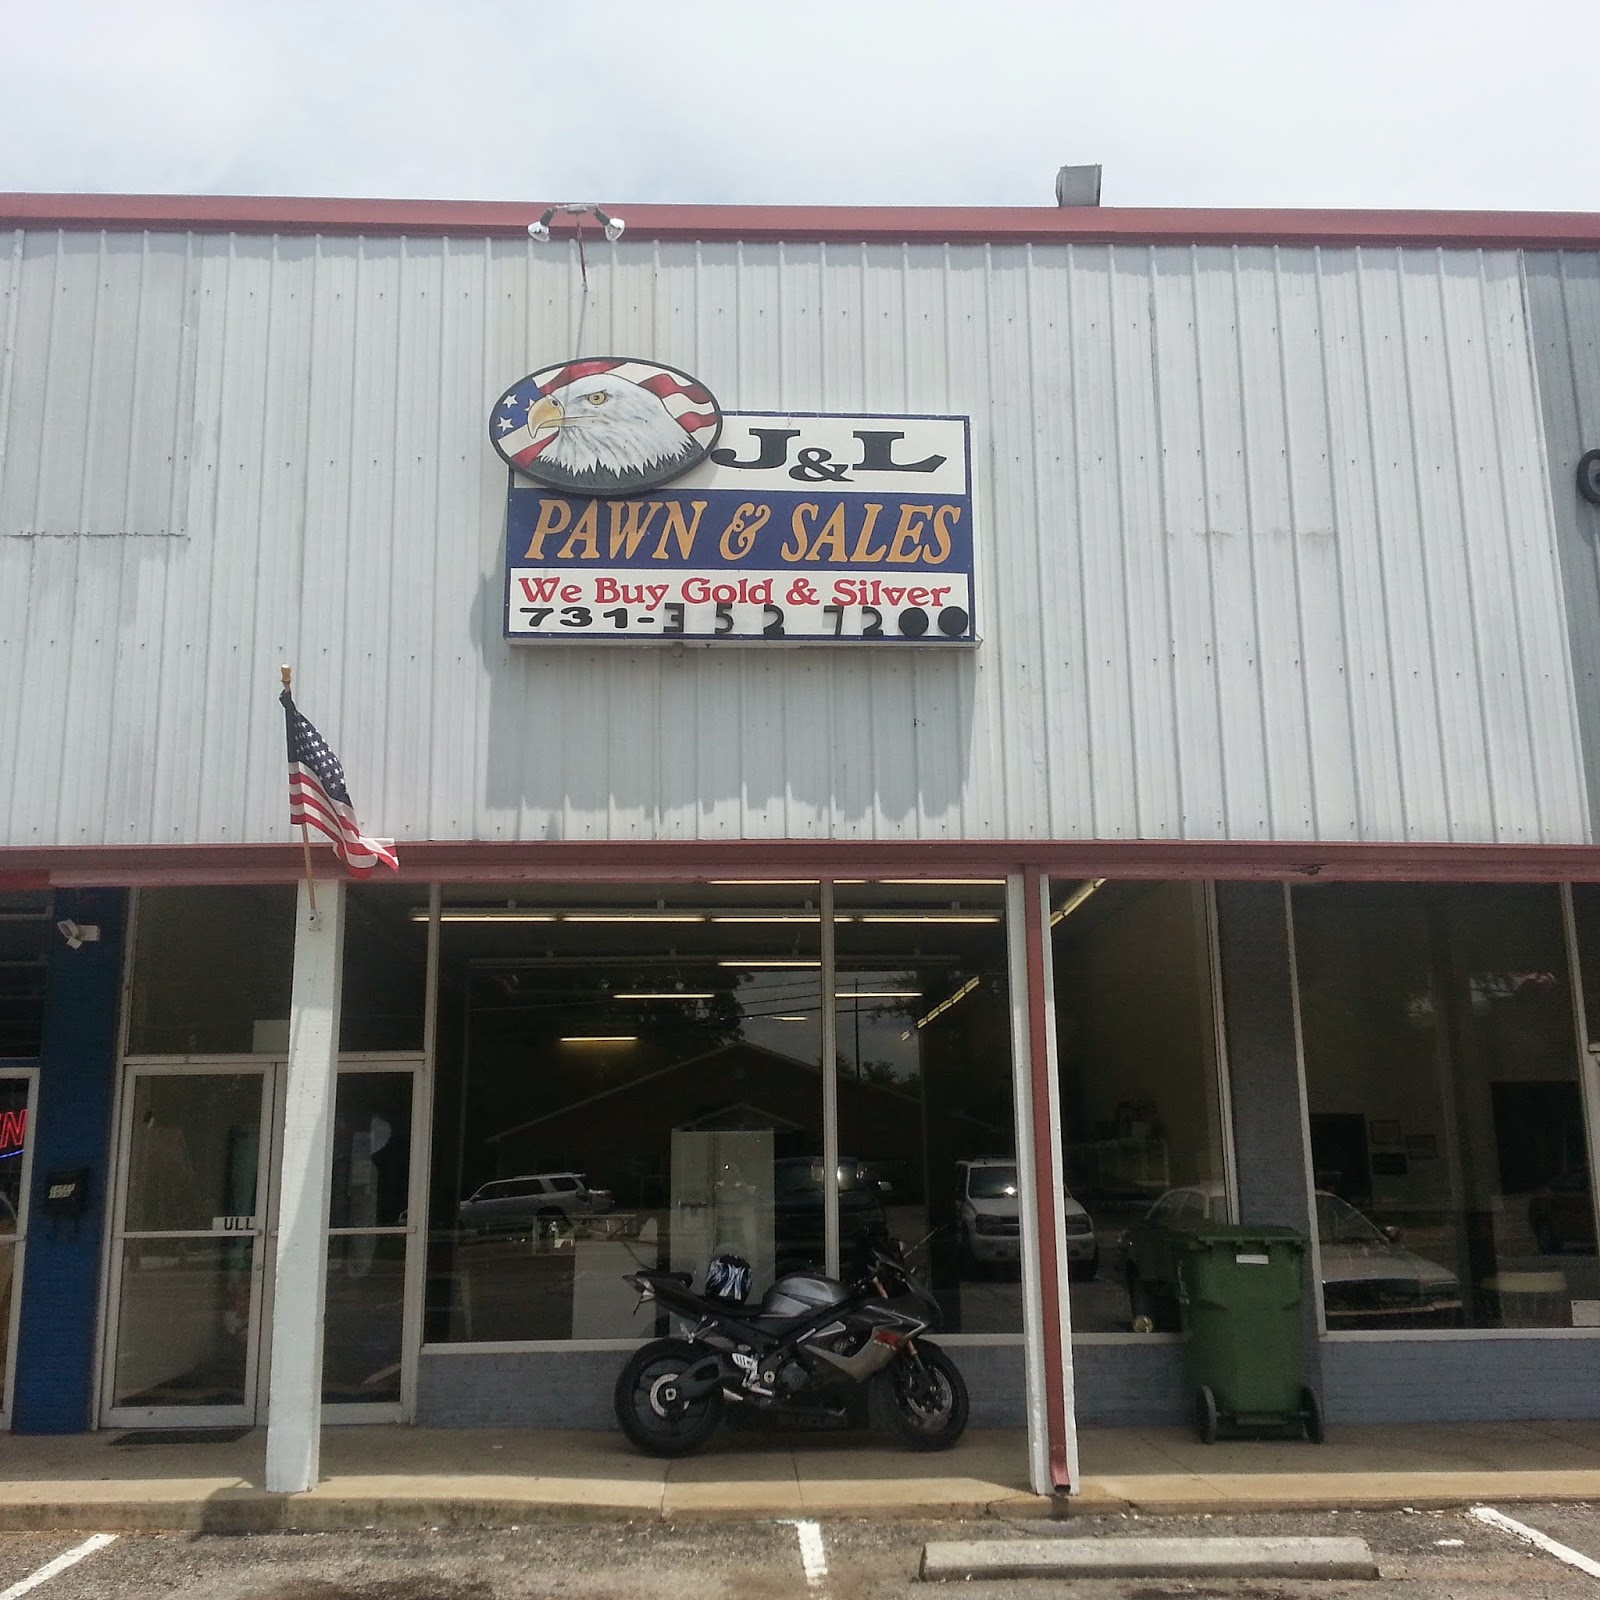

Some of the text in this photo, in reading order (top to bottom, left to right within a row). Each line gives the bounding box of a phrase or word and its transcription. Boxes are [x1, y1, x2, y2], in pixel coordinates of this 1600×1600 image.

[710, 428, 948, 482] J&L
[524, 498, 961, 564] PAWN & SALES
[518, 577, 951, 611] We Buy Gold & Silver
